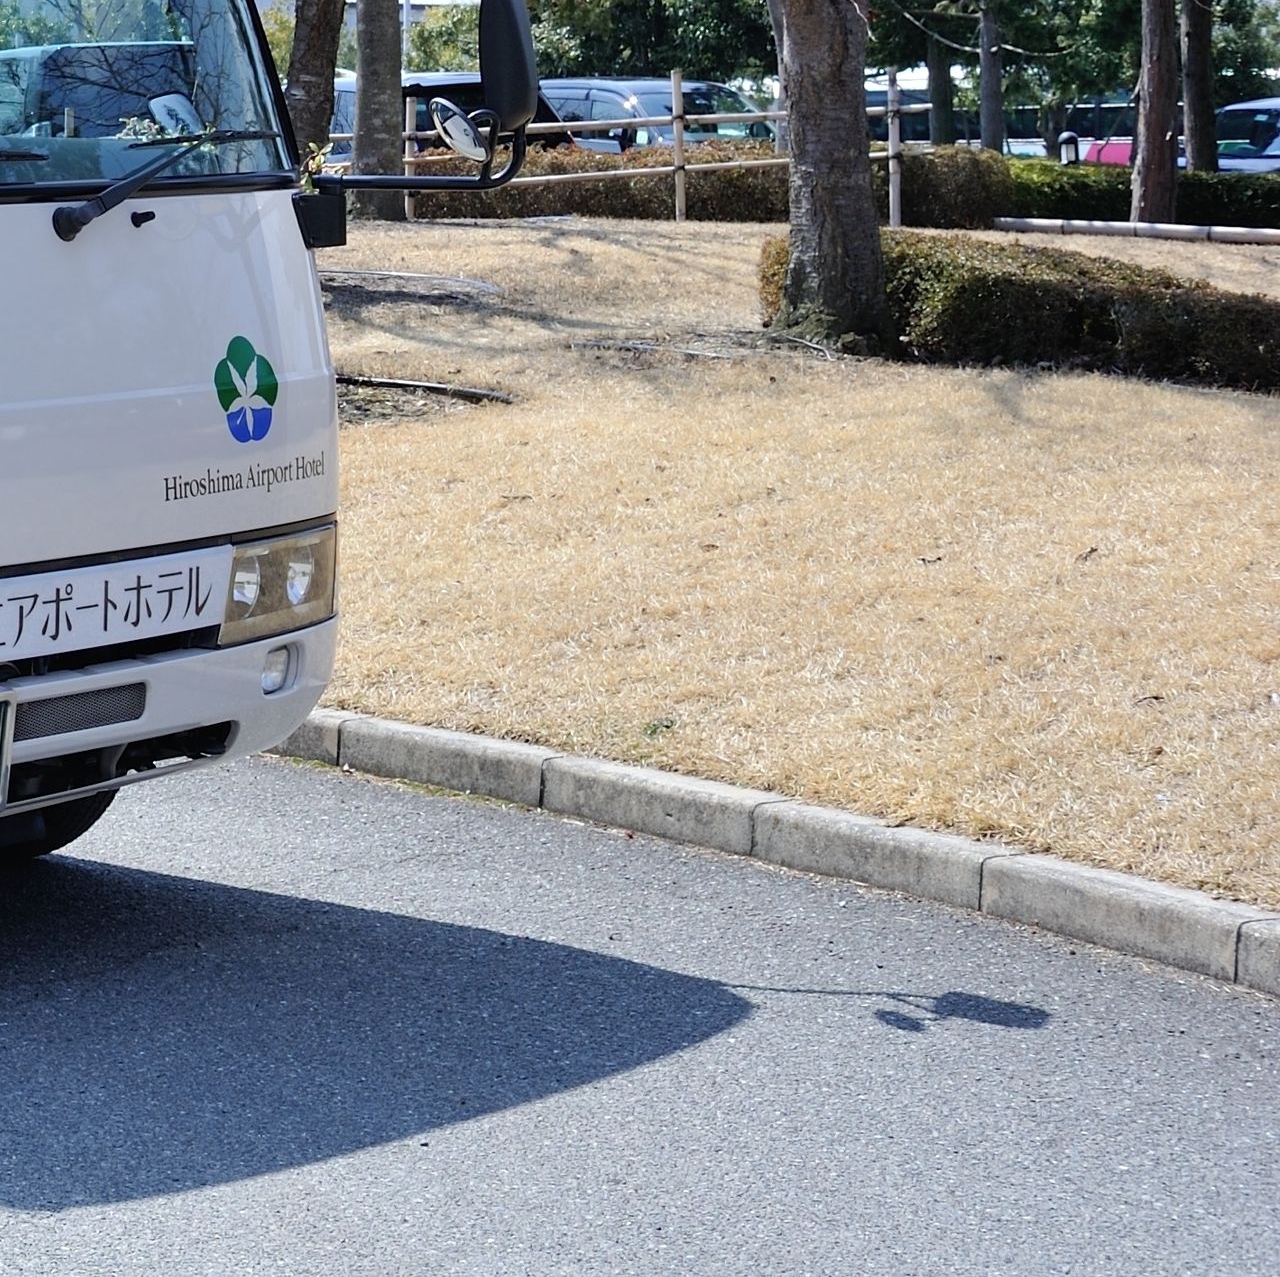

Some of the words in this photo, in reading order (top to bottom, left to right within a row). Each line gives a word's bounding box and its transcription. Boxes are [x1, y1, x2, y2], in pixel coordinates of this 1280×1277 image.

[163, 468, 243, 502] Hiroshima
[246, 463, 293, 492] Airport
[295, 450, 326, 480] Hotel
